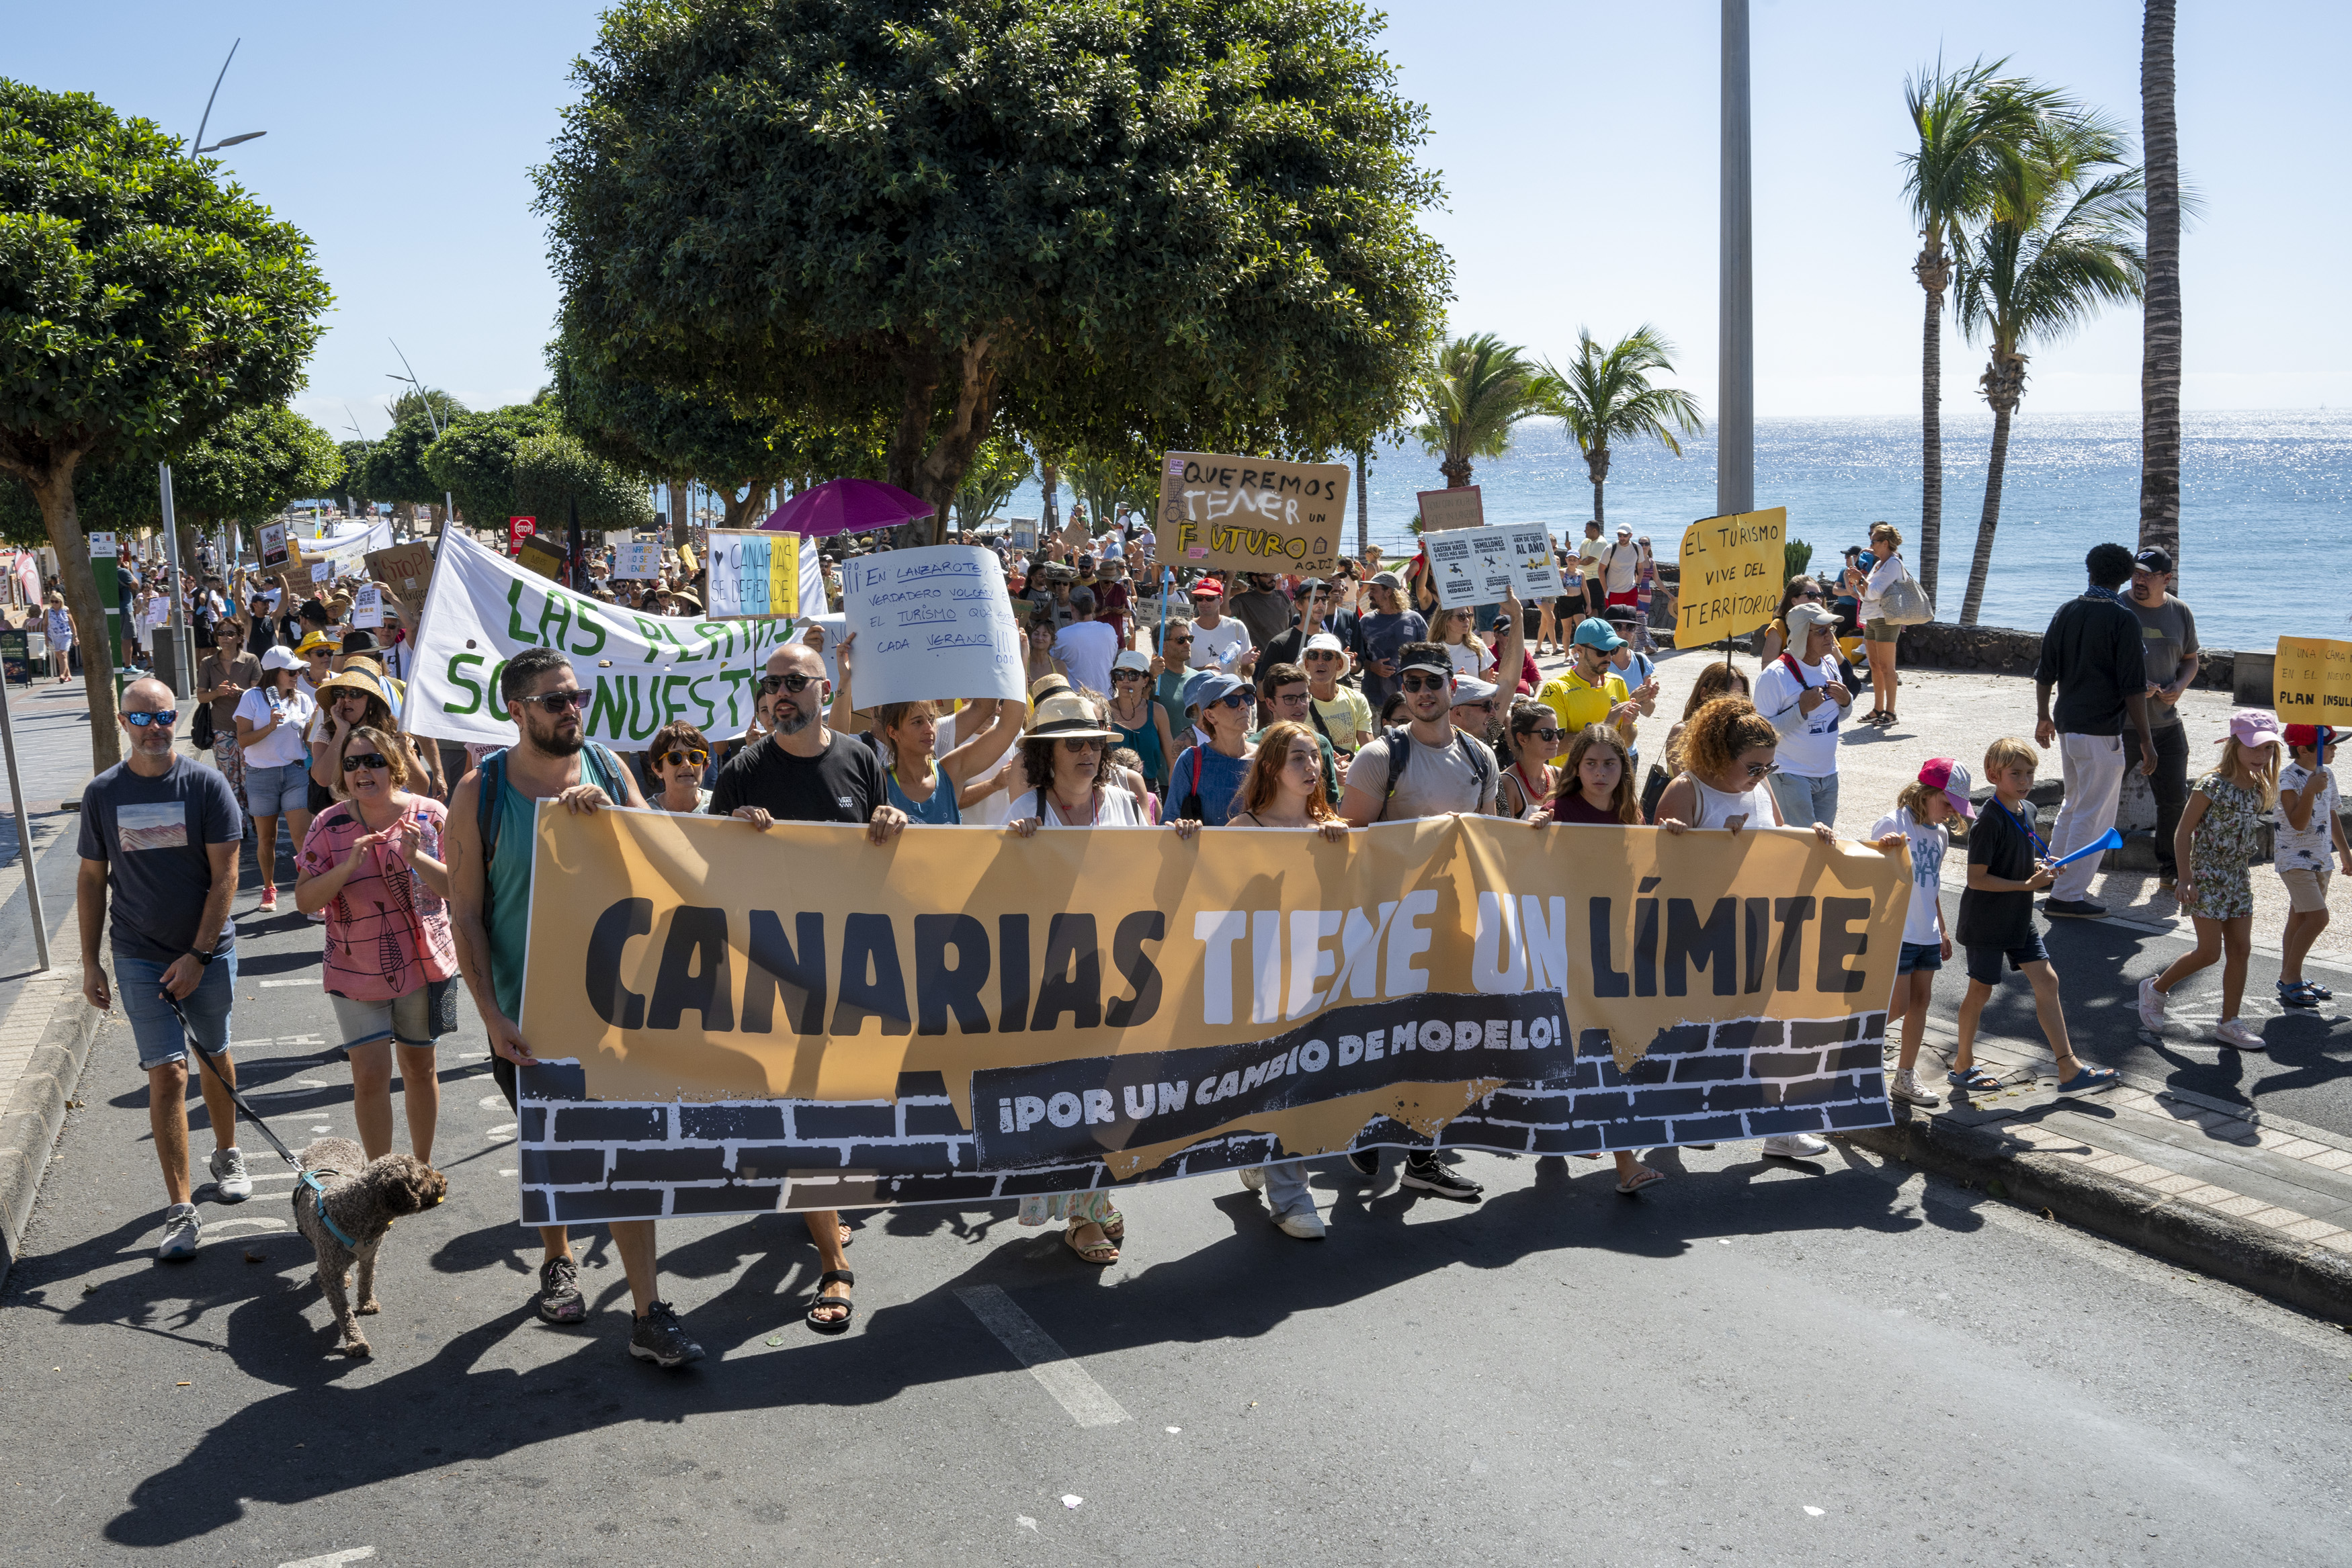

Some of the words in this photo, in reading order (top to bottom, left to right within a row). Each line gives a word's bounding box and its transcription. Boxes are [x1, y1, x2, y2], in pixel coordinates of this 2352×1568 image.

[1184, 462, 1335, 500] QUEREMOS
[1184, 489, 1300, 525] TENER
[1442, 498, 1454, 508] CAN
[1309, 513, 1326, 523] UN
[1178, 519, 1306, 560] FUTURO
[1474, 540, 1504, 549] 16MILLONES
[1516, 544, 1527, 554] AL
[1528, 541, 1545, 554] AÑO
[1685, 531, 1706, 556] EL
[1718, 521, 1778, 548] TURISMO
[625, 546, 653, 554] CANARIAS
[730, 540, 793, 570] CANARIAS
[1706, 566, 1736, 586] VIVE
[1745, 563, 1765, 578] DEL
[711, 580, 726, 601] SE
[732, 574, 793, 603] DEFIENDE!
[868, 589, 941, 606] VERDADERO
[507, 579, 606, 656] LAS
[870, 616, 886, 627] EL
[898, 605, 957, 626] TURISMO
[1683, 589, 1776, 628] TERRITORIO
[878, 638, 911, 653] CADA
[926, 634, 993, 650] VERANO
[2297, 648, 2316, 658] UNA
[2325, 650, 2345, 662] CAMA
[2282, 668, 2294, 679] EN
[2304, 670, 2318, 679] EL
[2327, 672, 2351, 681] NUEVO
[2279, 691, 2314, 705] PLAN
[585, 897, 1165, 1036] CANARIAS
[1193, 889, 1437, 1024] TIENE
[1472, 891, 1568, 998] UN
[1590, 877, 1872, 998] LÍMITE
[999, 1089, 1115, 1133] ¡POR
[1124, 1080, 1189, 1119] UN
[1195, 1039, 1330, 1105] CAMBIO
[1339, 1029, 1385, 1067] DE
[1391, 1015, 1562, 1055] MODELO!
